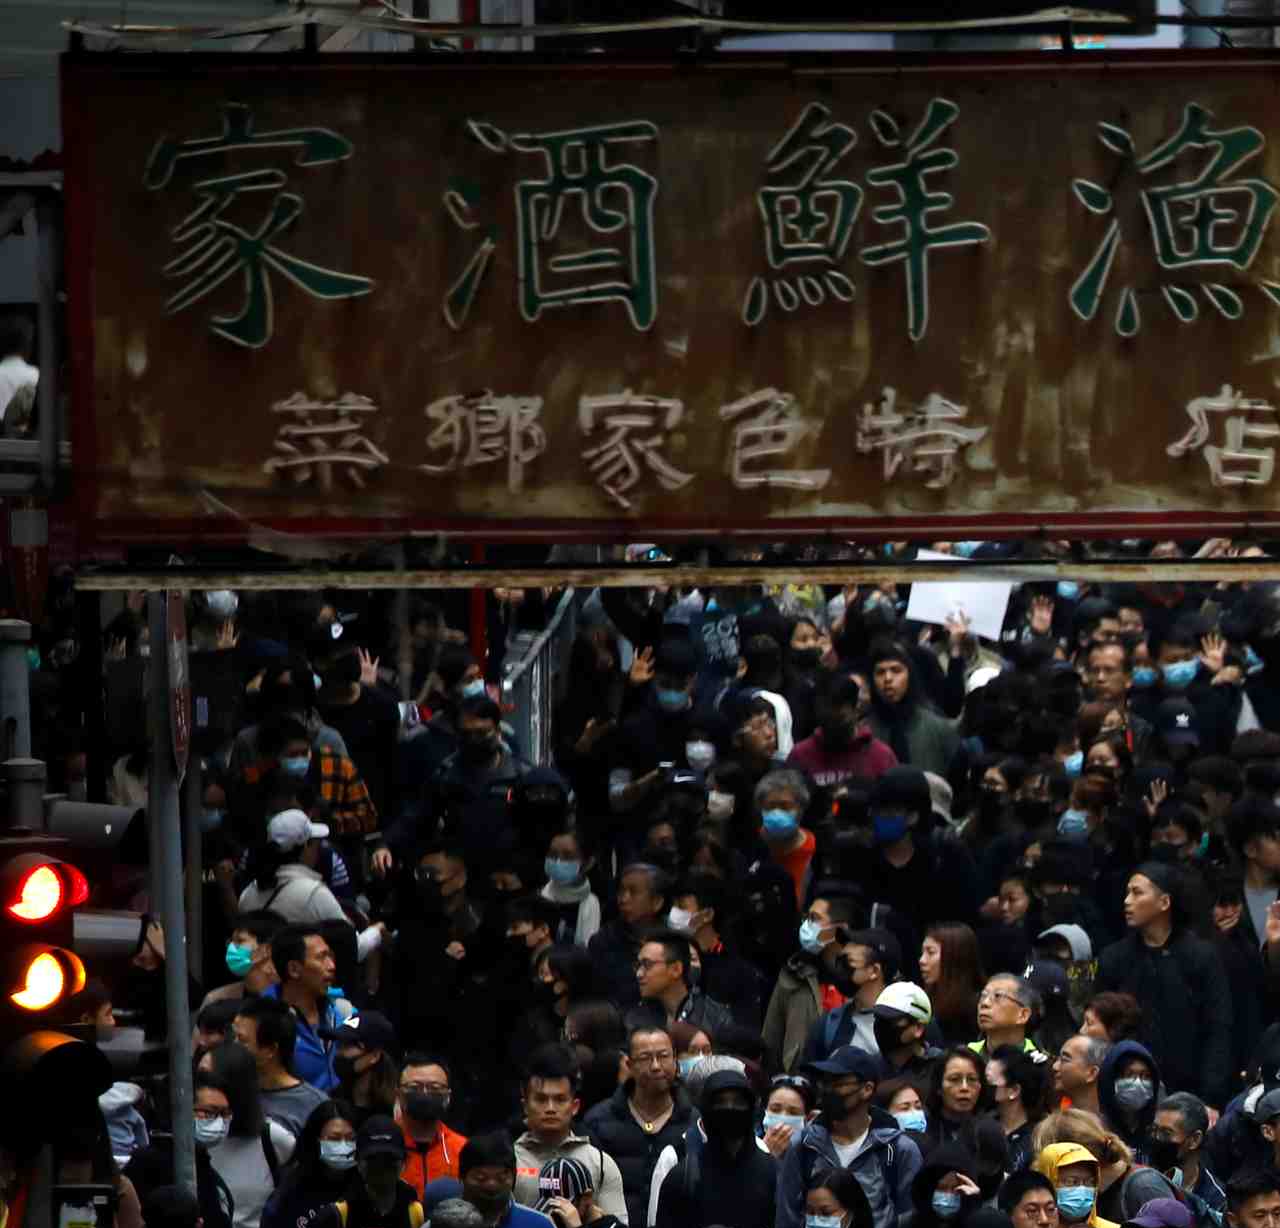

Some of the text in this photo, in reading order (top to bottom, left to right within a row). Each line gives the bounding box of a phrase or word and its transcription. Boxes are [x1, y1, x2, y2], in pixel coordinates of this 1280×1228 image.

[264, 385, 989, 507] 特色家鄉菜
